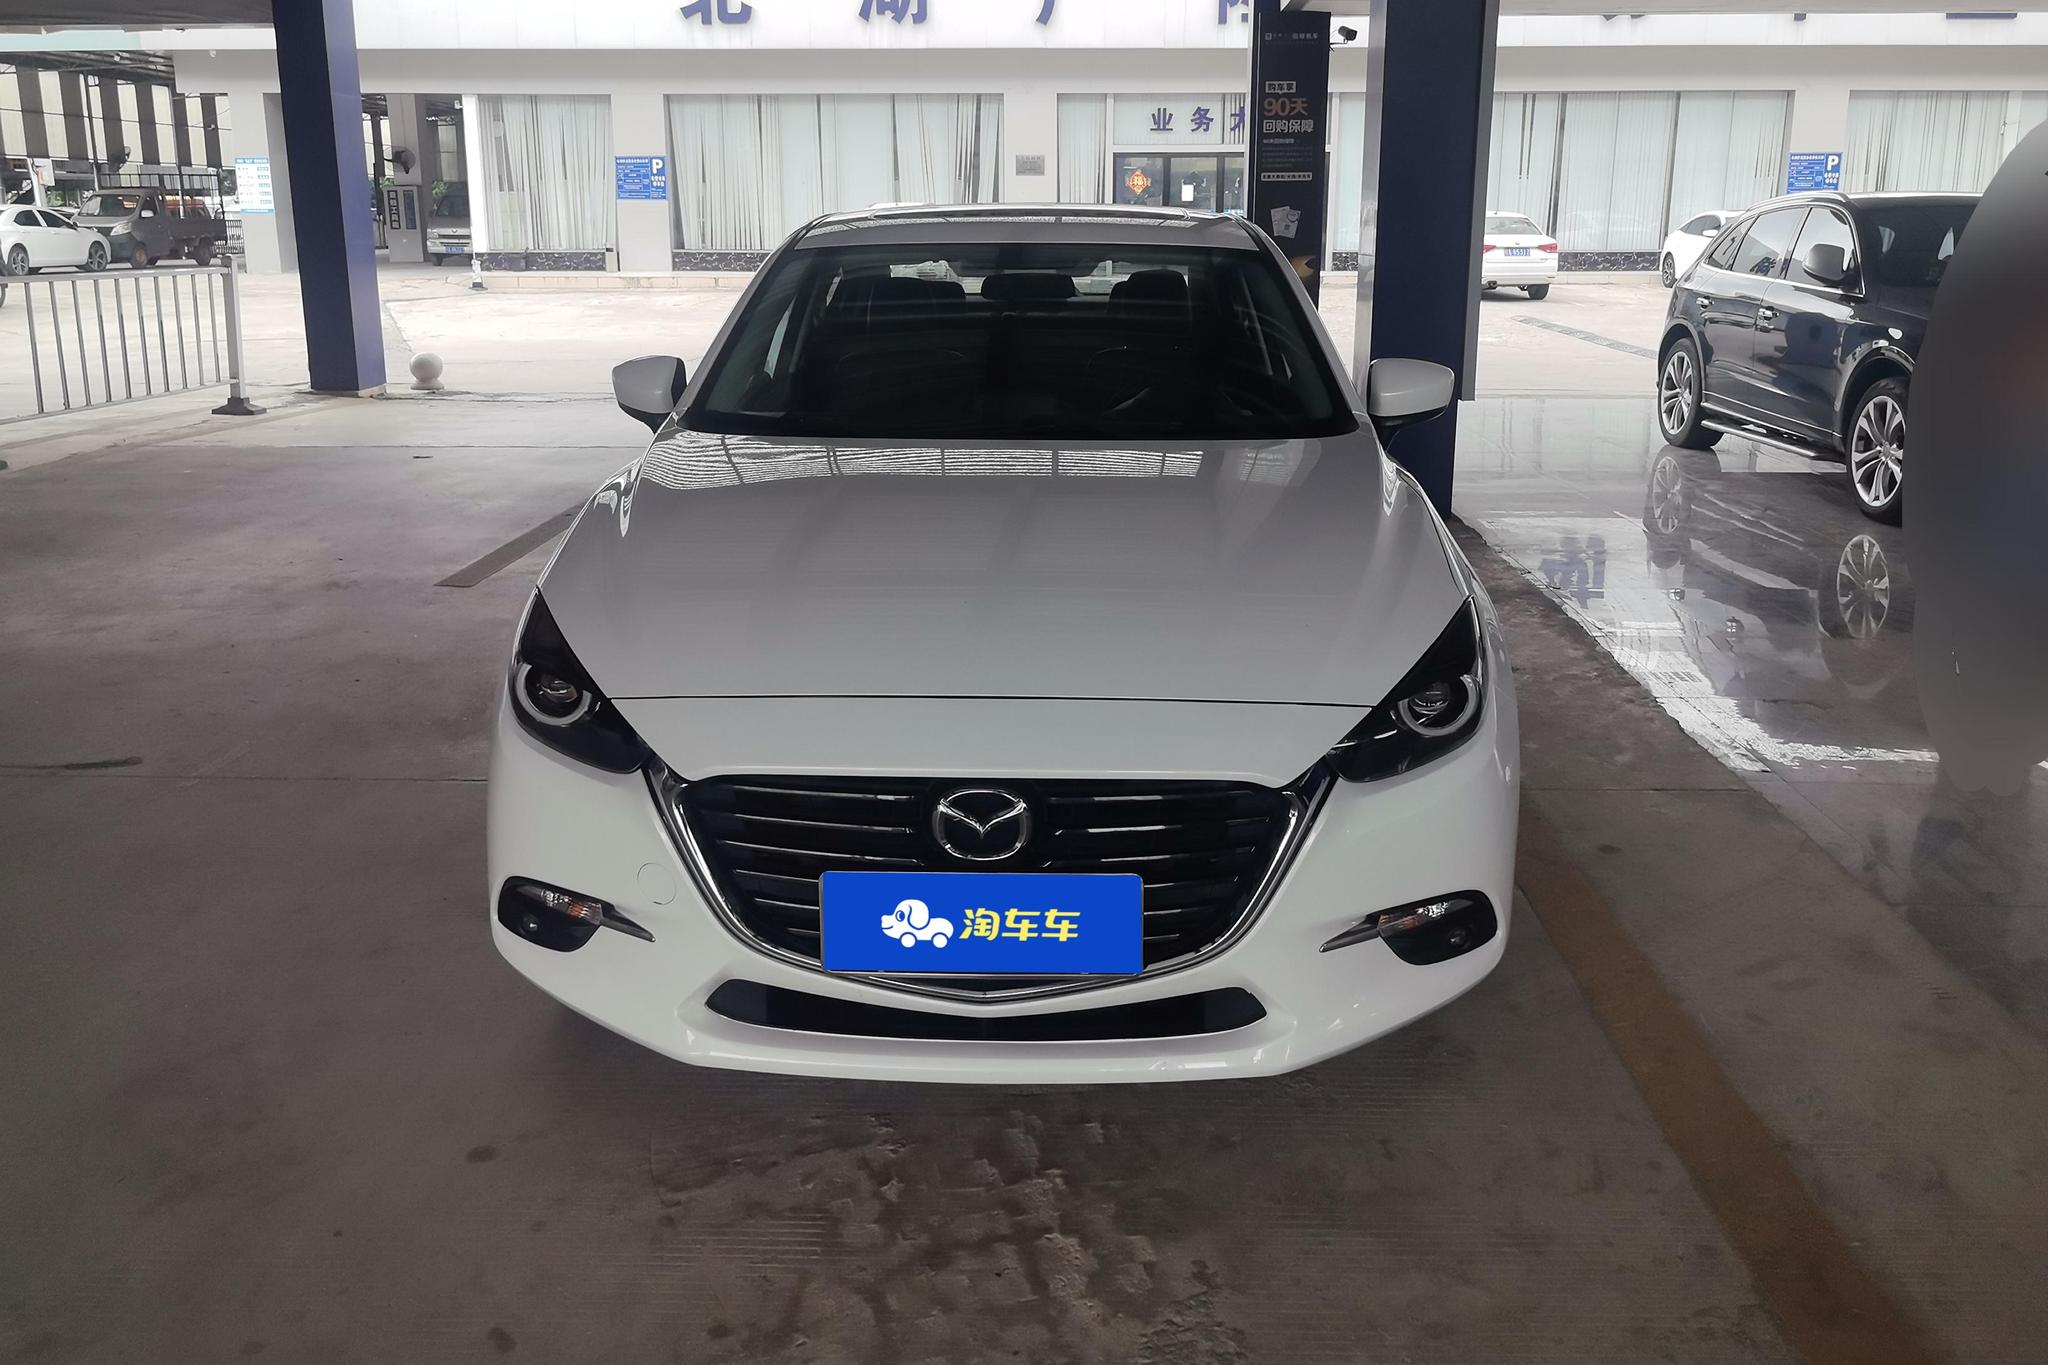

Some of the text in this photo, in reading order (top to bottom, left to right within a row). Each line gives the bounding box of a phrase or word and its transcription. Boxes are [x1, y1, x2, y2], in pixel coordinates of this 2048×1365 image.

[1263, 97, 1308, 117] 90天
[1263, 119, 1314, 133] 回购保障
[652, 158, 663, 174] P
[1827, 155, 1839, 171] P
